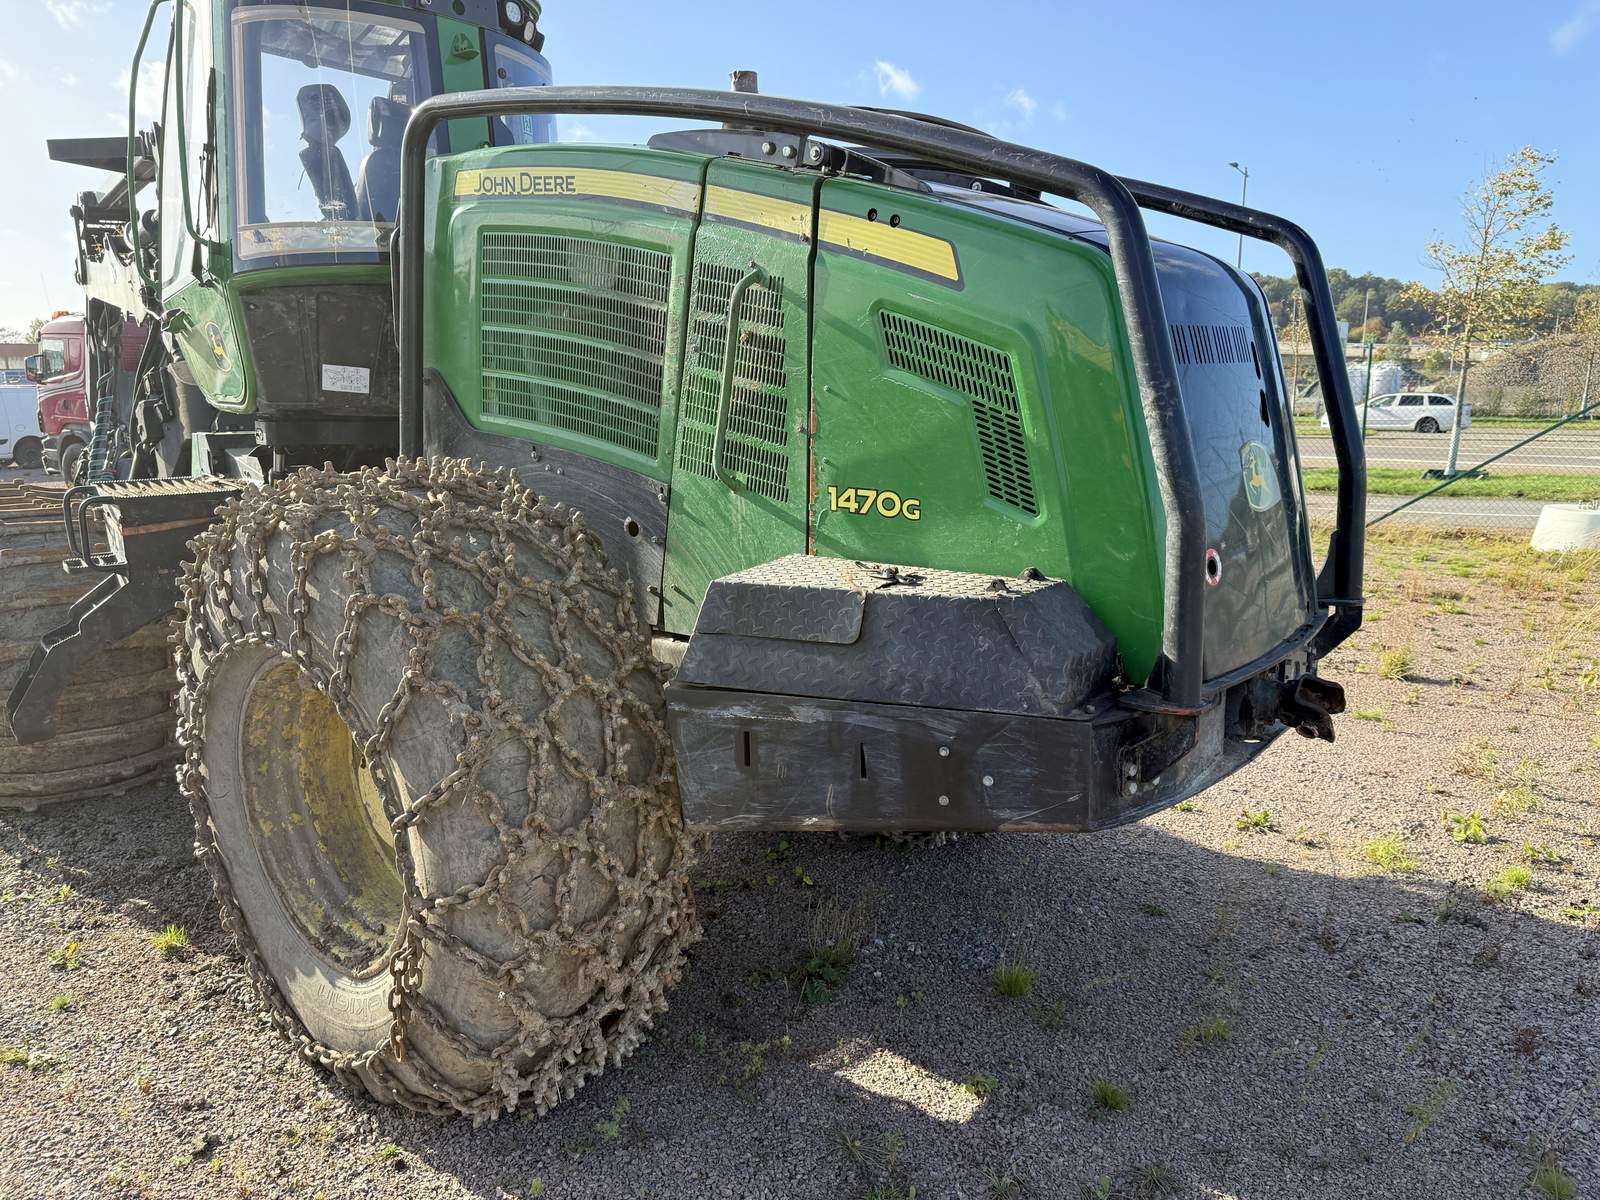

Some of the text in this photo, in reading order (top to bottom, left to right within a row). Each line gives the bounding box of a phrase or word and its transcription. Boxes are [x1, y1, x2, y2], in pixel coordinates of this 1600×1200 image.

[474, 172, 576, 193] JOHN DEERE
[827, 485, 921, 520] 1470G
